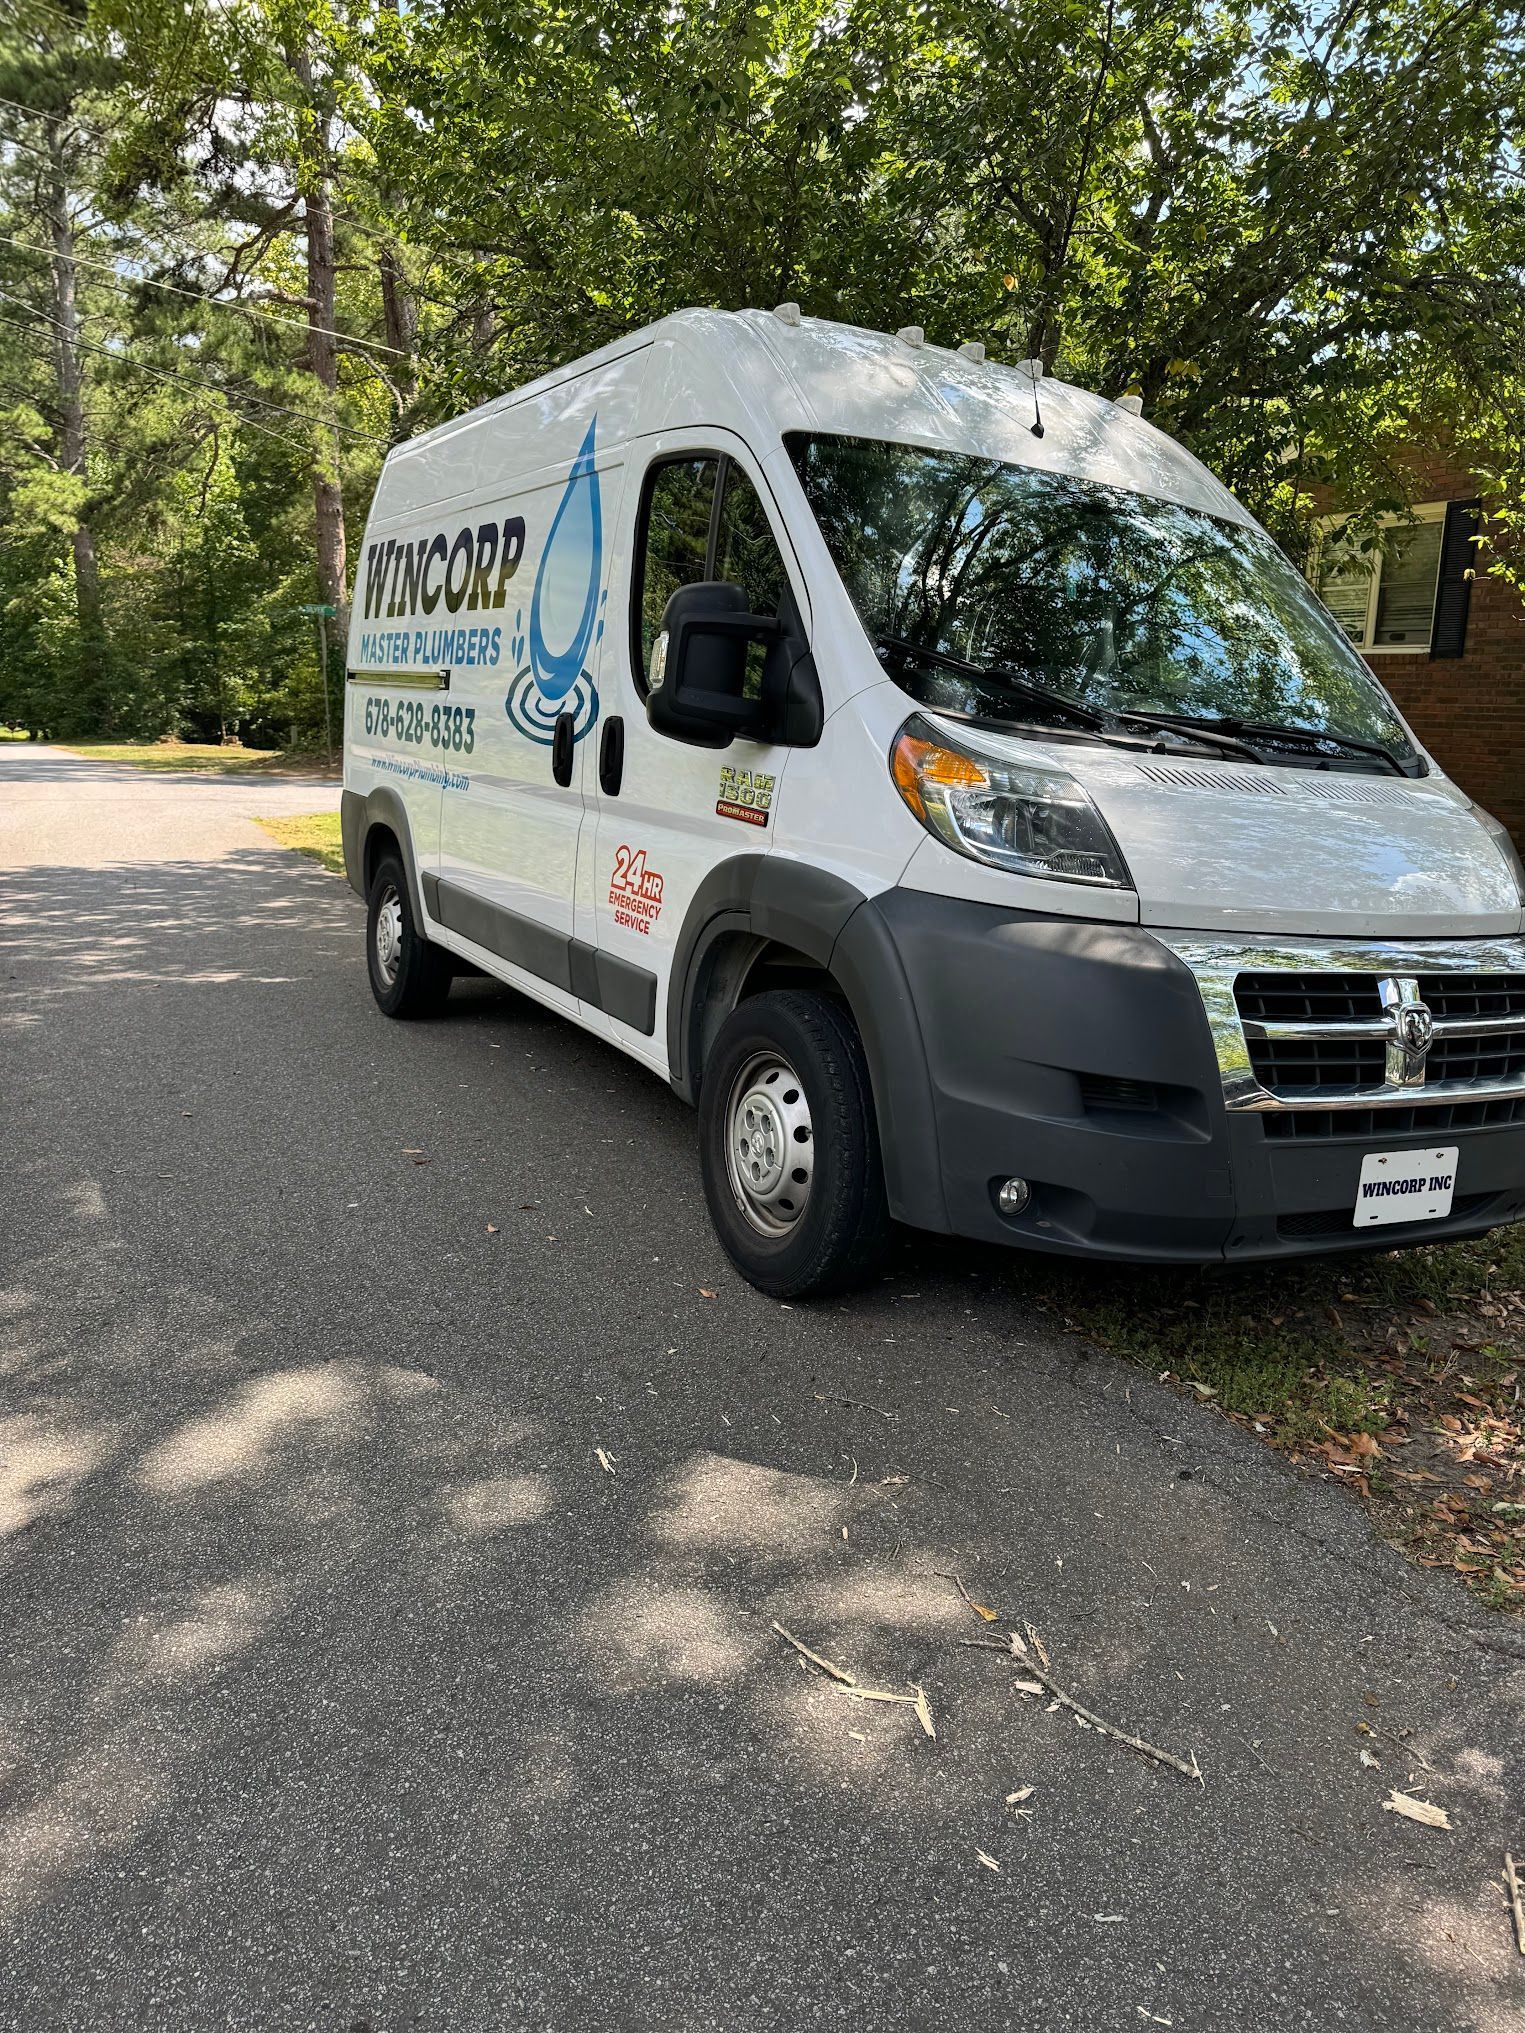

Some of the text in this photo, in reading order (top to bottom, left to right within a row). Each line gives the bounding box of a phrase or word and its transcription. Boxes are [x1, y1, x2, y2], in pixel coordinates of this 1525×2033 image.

[364, 516, 526, 619] WINCORP
[360, 626, 502, 665] MASTER PLUMBERS
[365, 697, 476, 754] 678-628-8383
[720, 765, 776, 793] RAM
[608, 890, 661, 920] EMERGENCY
[614, 910, 650, 935] SERVICE
[1363, 1175, 1452, 1198] WINCORP INC
